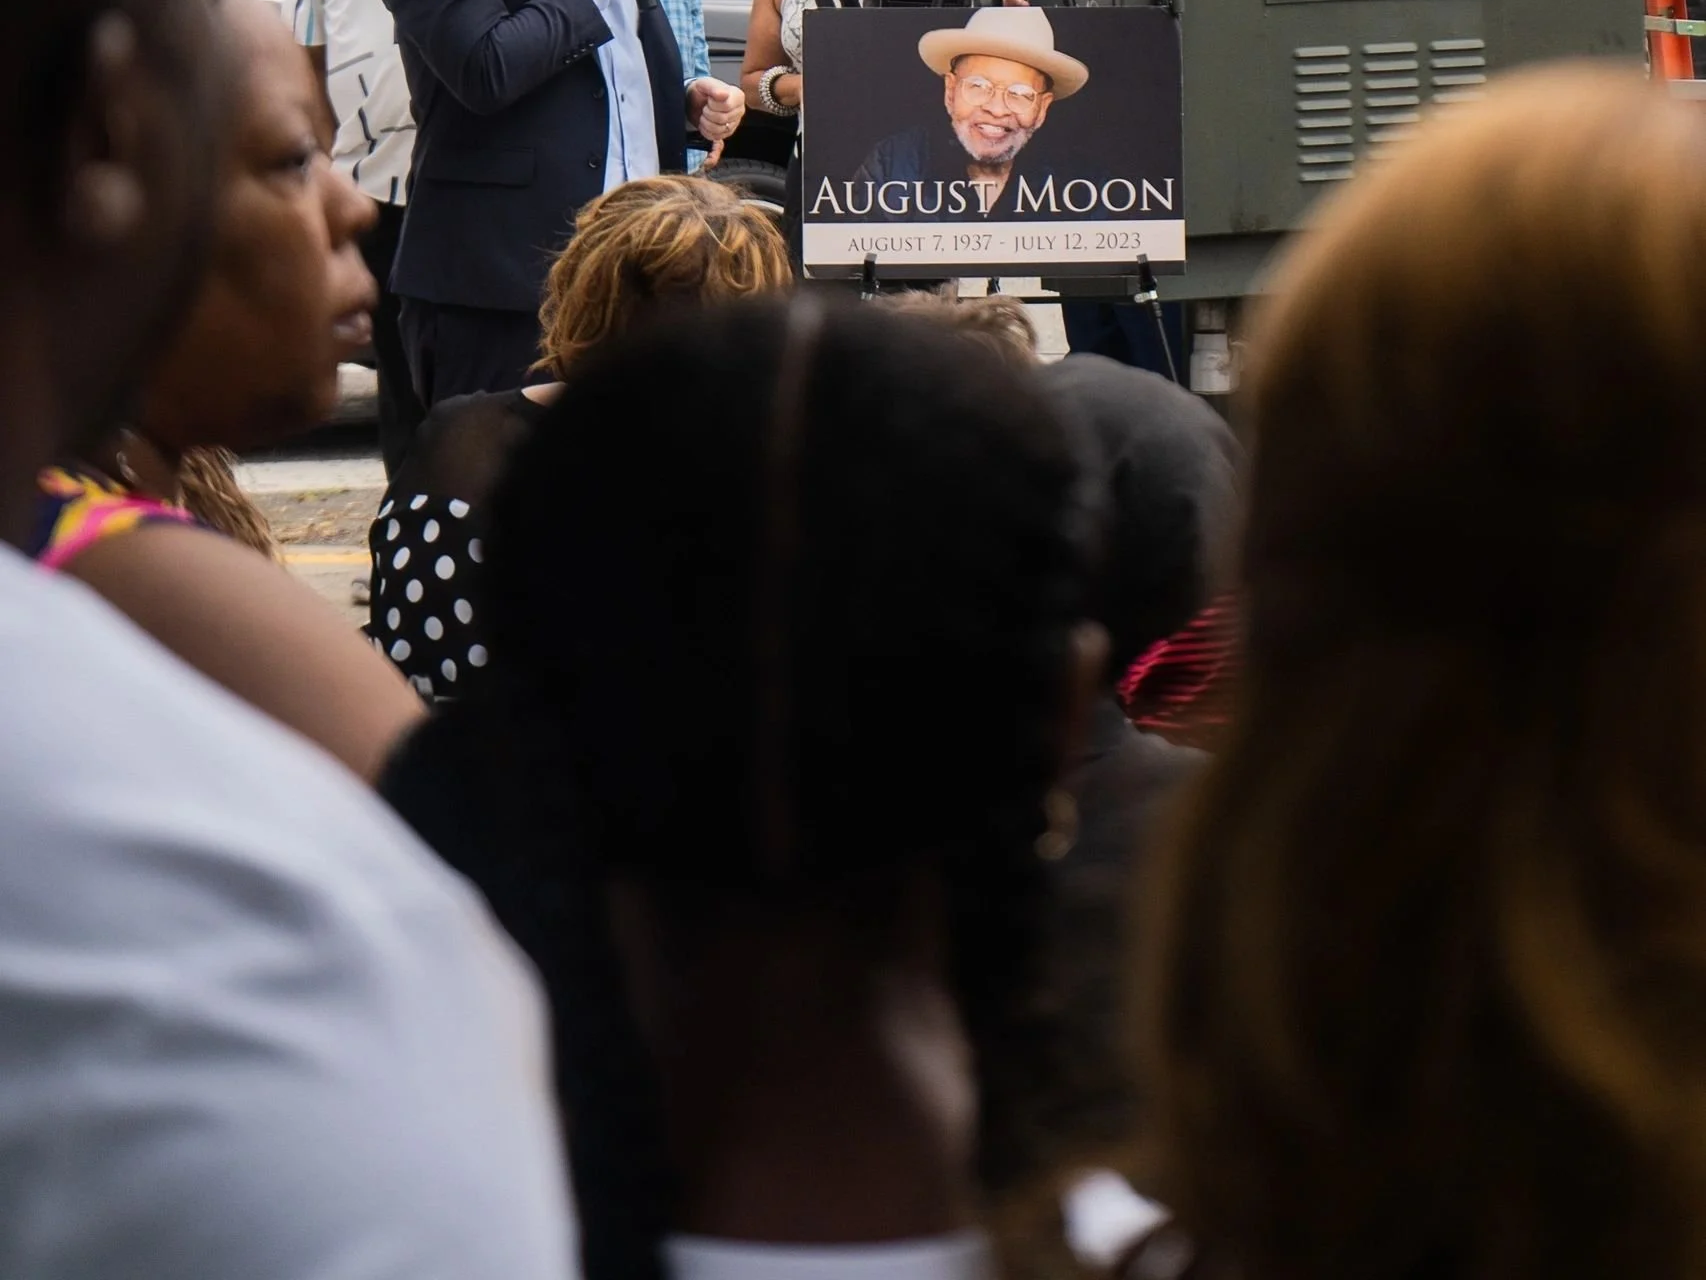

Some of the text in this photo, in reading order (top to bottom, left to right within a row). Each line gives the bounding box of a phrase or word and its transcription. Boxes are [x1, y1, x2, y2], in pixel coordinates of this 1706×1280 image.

[809, 175, 1175, 215] AUGUST MOON
[848, 236, 926, 252] AUGUST
[932, 235, 945, 253] 7,
[954, 234, 992, 251] 1937
[1013, 235, 1057, 254] JULY
[1065, 233, 1089, 251] 12,
[1095, 232, 1142, 250] 2023
